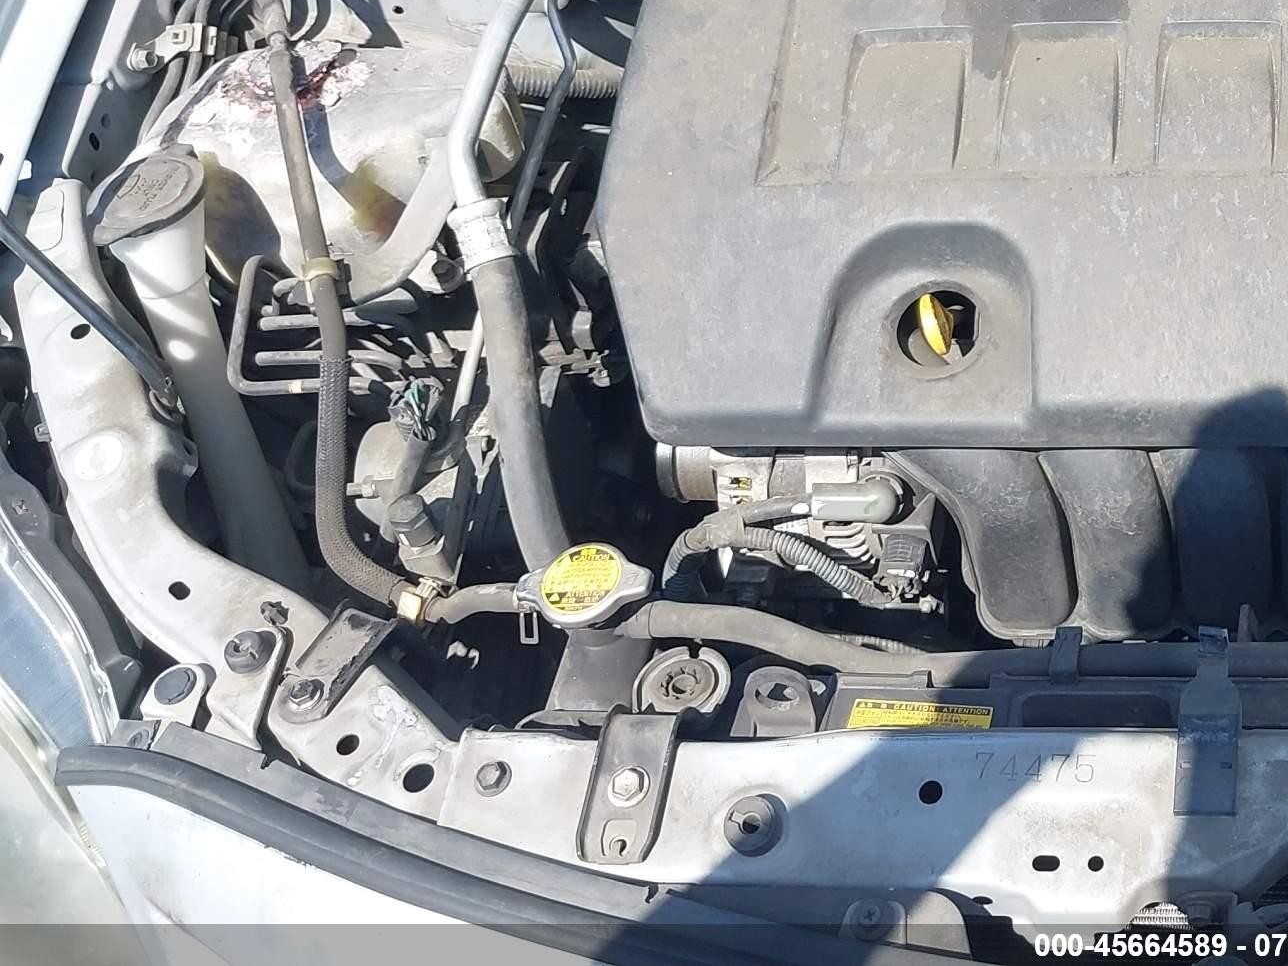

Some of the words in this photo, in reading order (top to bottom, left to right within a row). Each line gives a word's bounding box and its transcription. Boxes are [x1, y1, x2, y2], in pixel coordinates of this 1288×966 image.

[572, 553, 609, 562] CAUTION
[564, 589, 606, 598] ATTENTION
[893, 702, 936, 713] CAUTION
[942, 706, 990, 716] ATTENTION
[975, 751, 1097, 783] 74475
